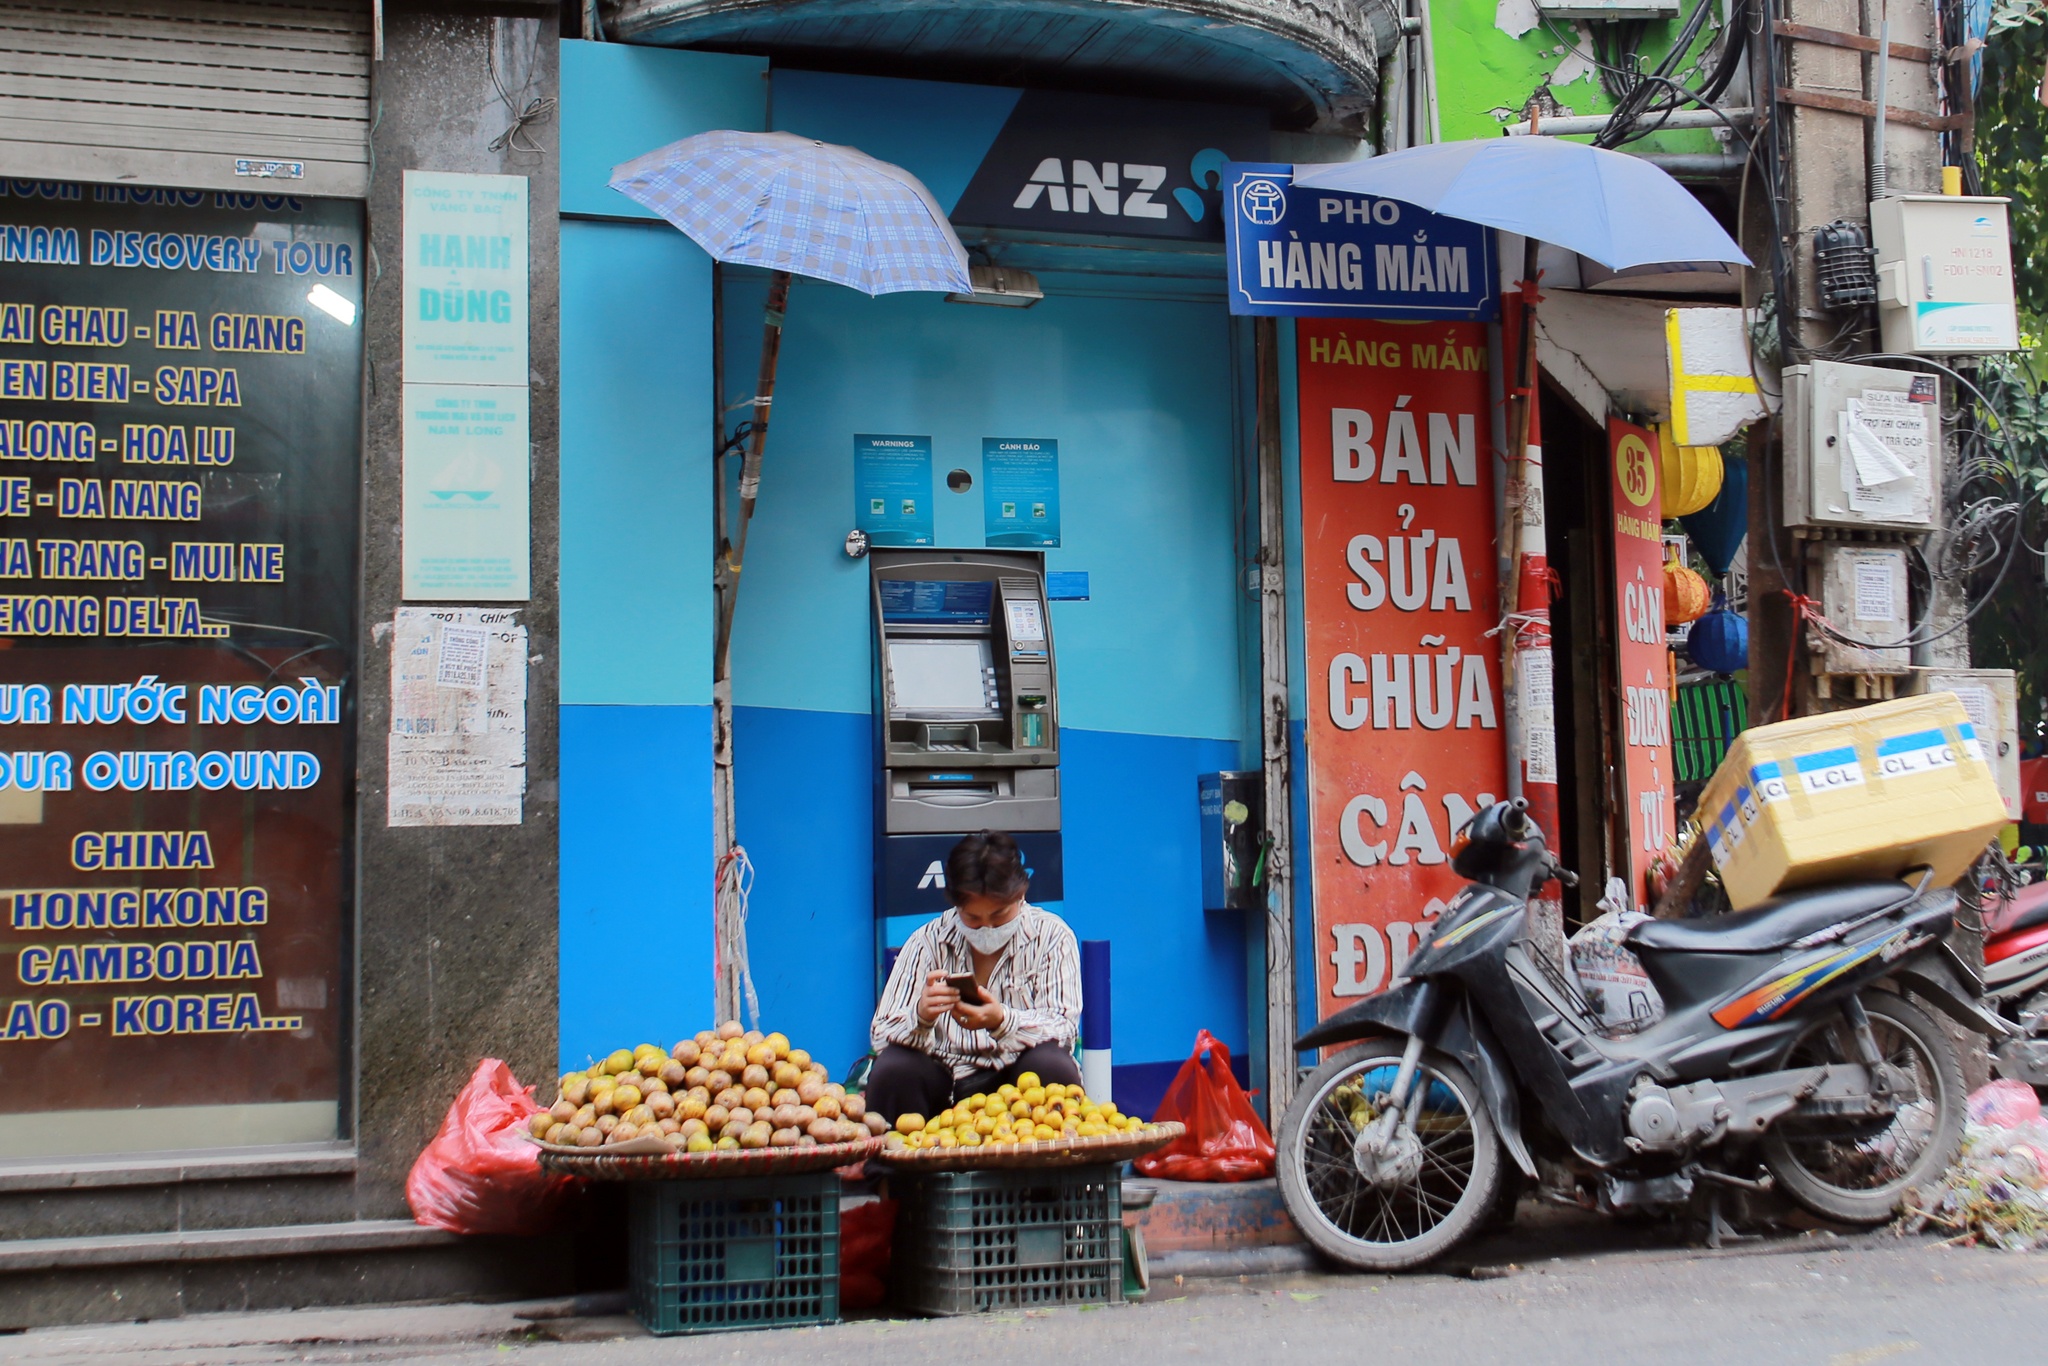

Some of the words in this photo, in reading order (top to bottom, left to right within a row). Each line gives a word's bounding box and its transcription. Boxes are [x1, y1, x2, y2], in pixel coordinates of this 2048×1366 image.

[457, 190, 474, 199] TY
[1012, 158, 1168, 220] ANZ
[0, 225, 80, 264] NAM
[90, 230, 262, 273] DISCOVERY
[272, 240, 353, 276] TOUR
[1258, 230, 1363, 292] HÀNG
[1375, 229, 1470, 294] MẮM
[0, 304, 34, 343] AI
[40, 306, 128, 347] CHAU
[155, 310, 200, 350] HA
[210, 313, 305, 354] GIANG
[1310, 332, 1401, 368] HÀNG
[1411, 329, 1489, 372] MẮM
[0, 360, 46, 400] EN
[52, 360, 129, 403] BIEN
[155, 366, 242, 407] SAPA
[123, 424, 190, 465] HOA
[194, 426, 236, 466] LU
[428, 425, 460, 436] NAM
[465, 426, 504, 437] LONG
[871, 440, 915, 448] WARNINGS
[1331, 395, 1478, 487] BÁN
[58, 478, 106, 518] DA
[110, 480, 201, 521] NANG
[1617, 510, 1640, 538] HÀNG
[37, 539, 145, 580] TRANG
[171, 542, 234, 582] MUI
[240, 543, 284, 582] NE
[1346, 503, 1472, 611] SỬA
[1625, 565, 1662, 645] CÂN
[62, 675, 187, 724] NƯỚC
[198, 676, 341, 724] NGOÀI
[1328, 634, 1498, 730] CHỮA
[1627, 668, 1668, 762] ĐIỆN
[82, 750, 321, 791] OUTBOUND
[1809, 768, 1857, 789] LCL
[1640, 767, 1666, 851] TỬ
[71, 831, 215, 871] CHINA
[18, 939, 263, 985] CAMBODIA
[0, 999, 70, 1040] AO
